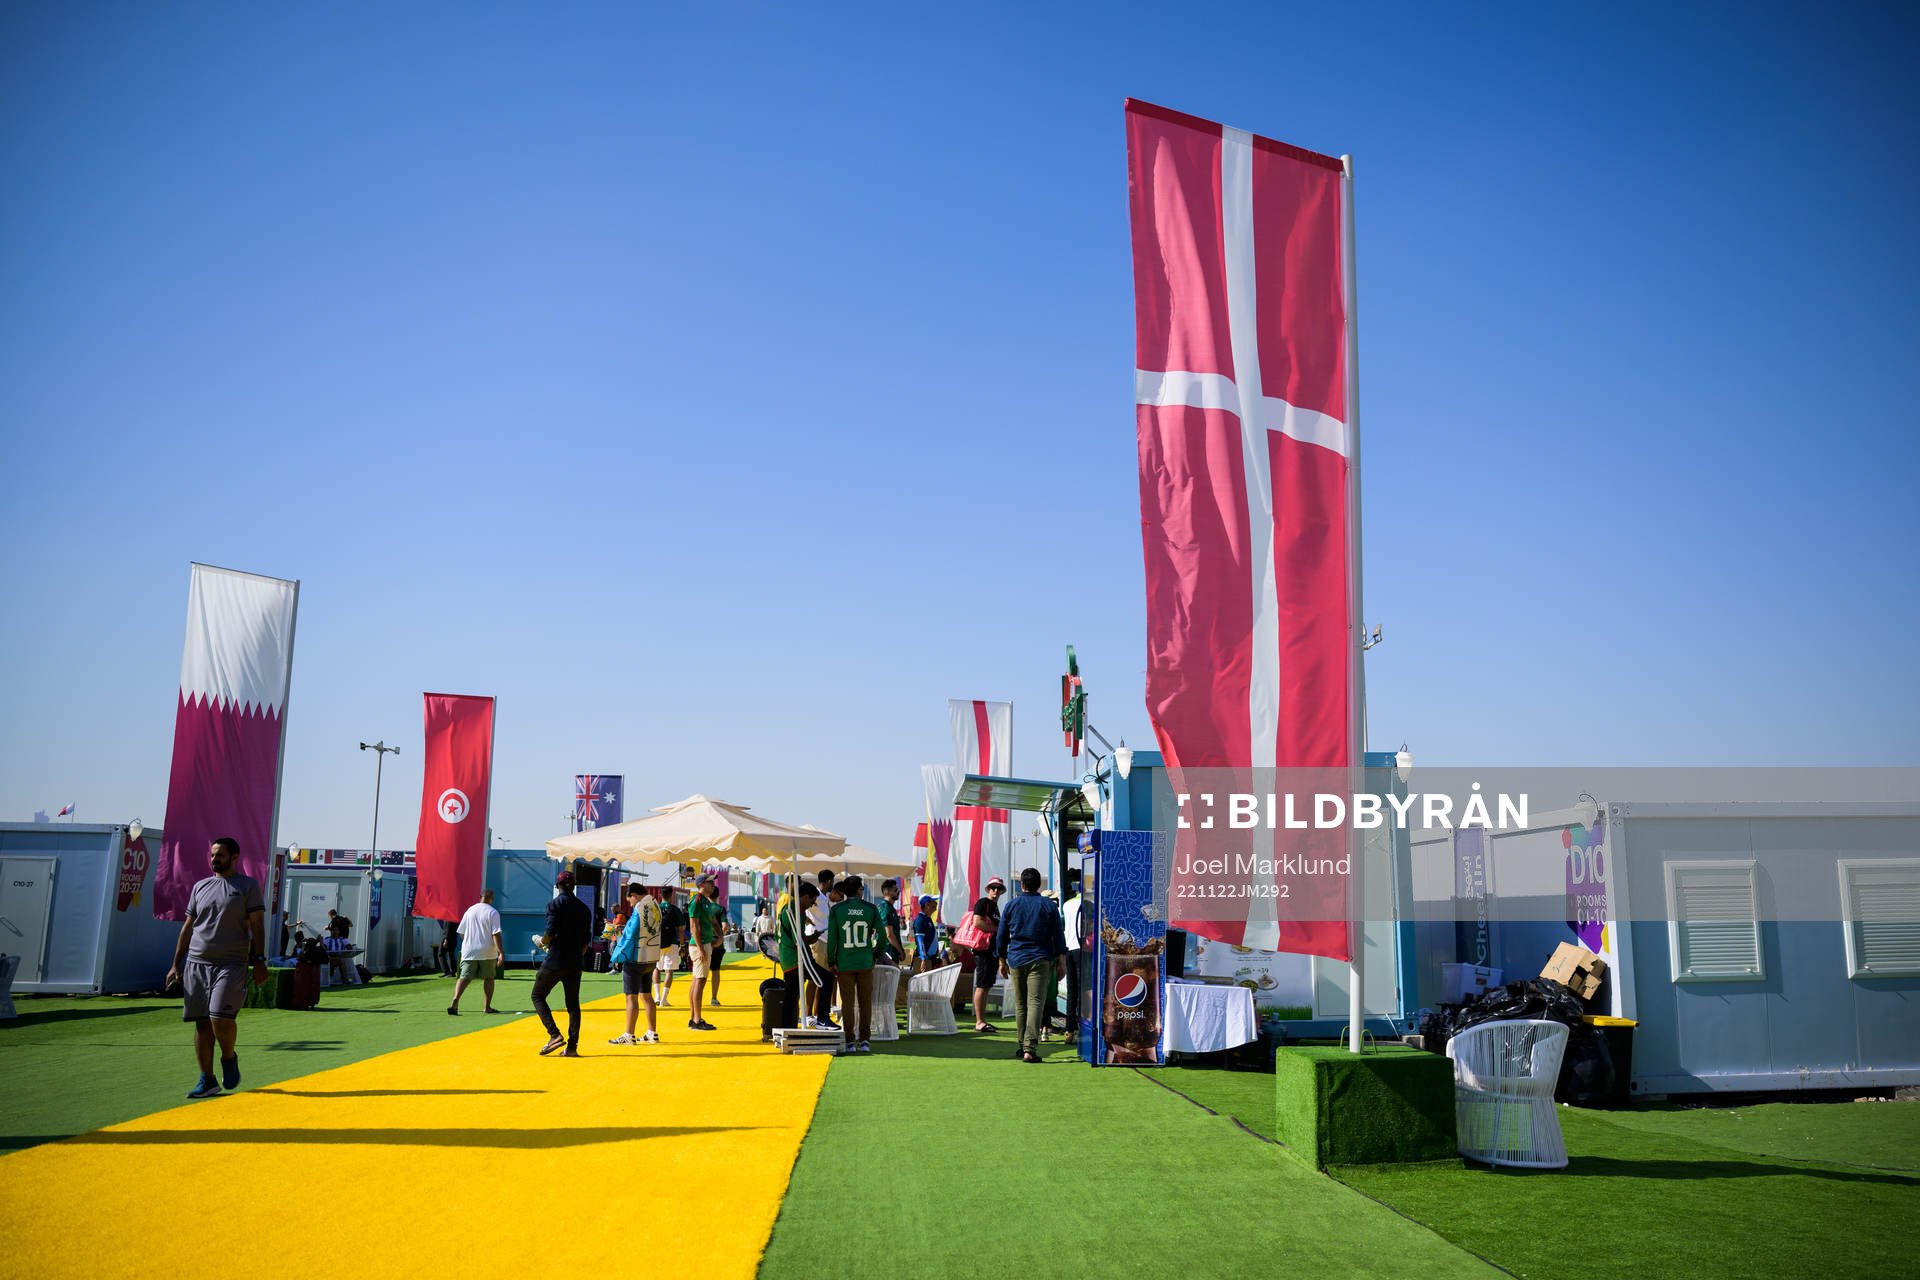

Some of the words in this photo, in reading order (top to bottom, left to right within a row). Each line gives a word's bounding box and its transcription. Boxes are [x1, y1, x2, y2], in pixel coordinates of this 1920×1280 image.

[122, 848, 145, 870] C10
[1103, 844, 1165, 864] TASTE
[1103, 863, 1165, 882] TASTE
[1571, 845, 1606, 884] D10
[1103, 881, 1165, 900] TASTE
[1576, 894, 1607, 907] ROOMS
[842, 920, 868, 948] 10
[1117, 1010, 1144, 1020] pepsi
